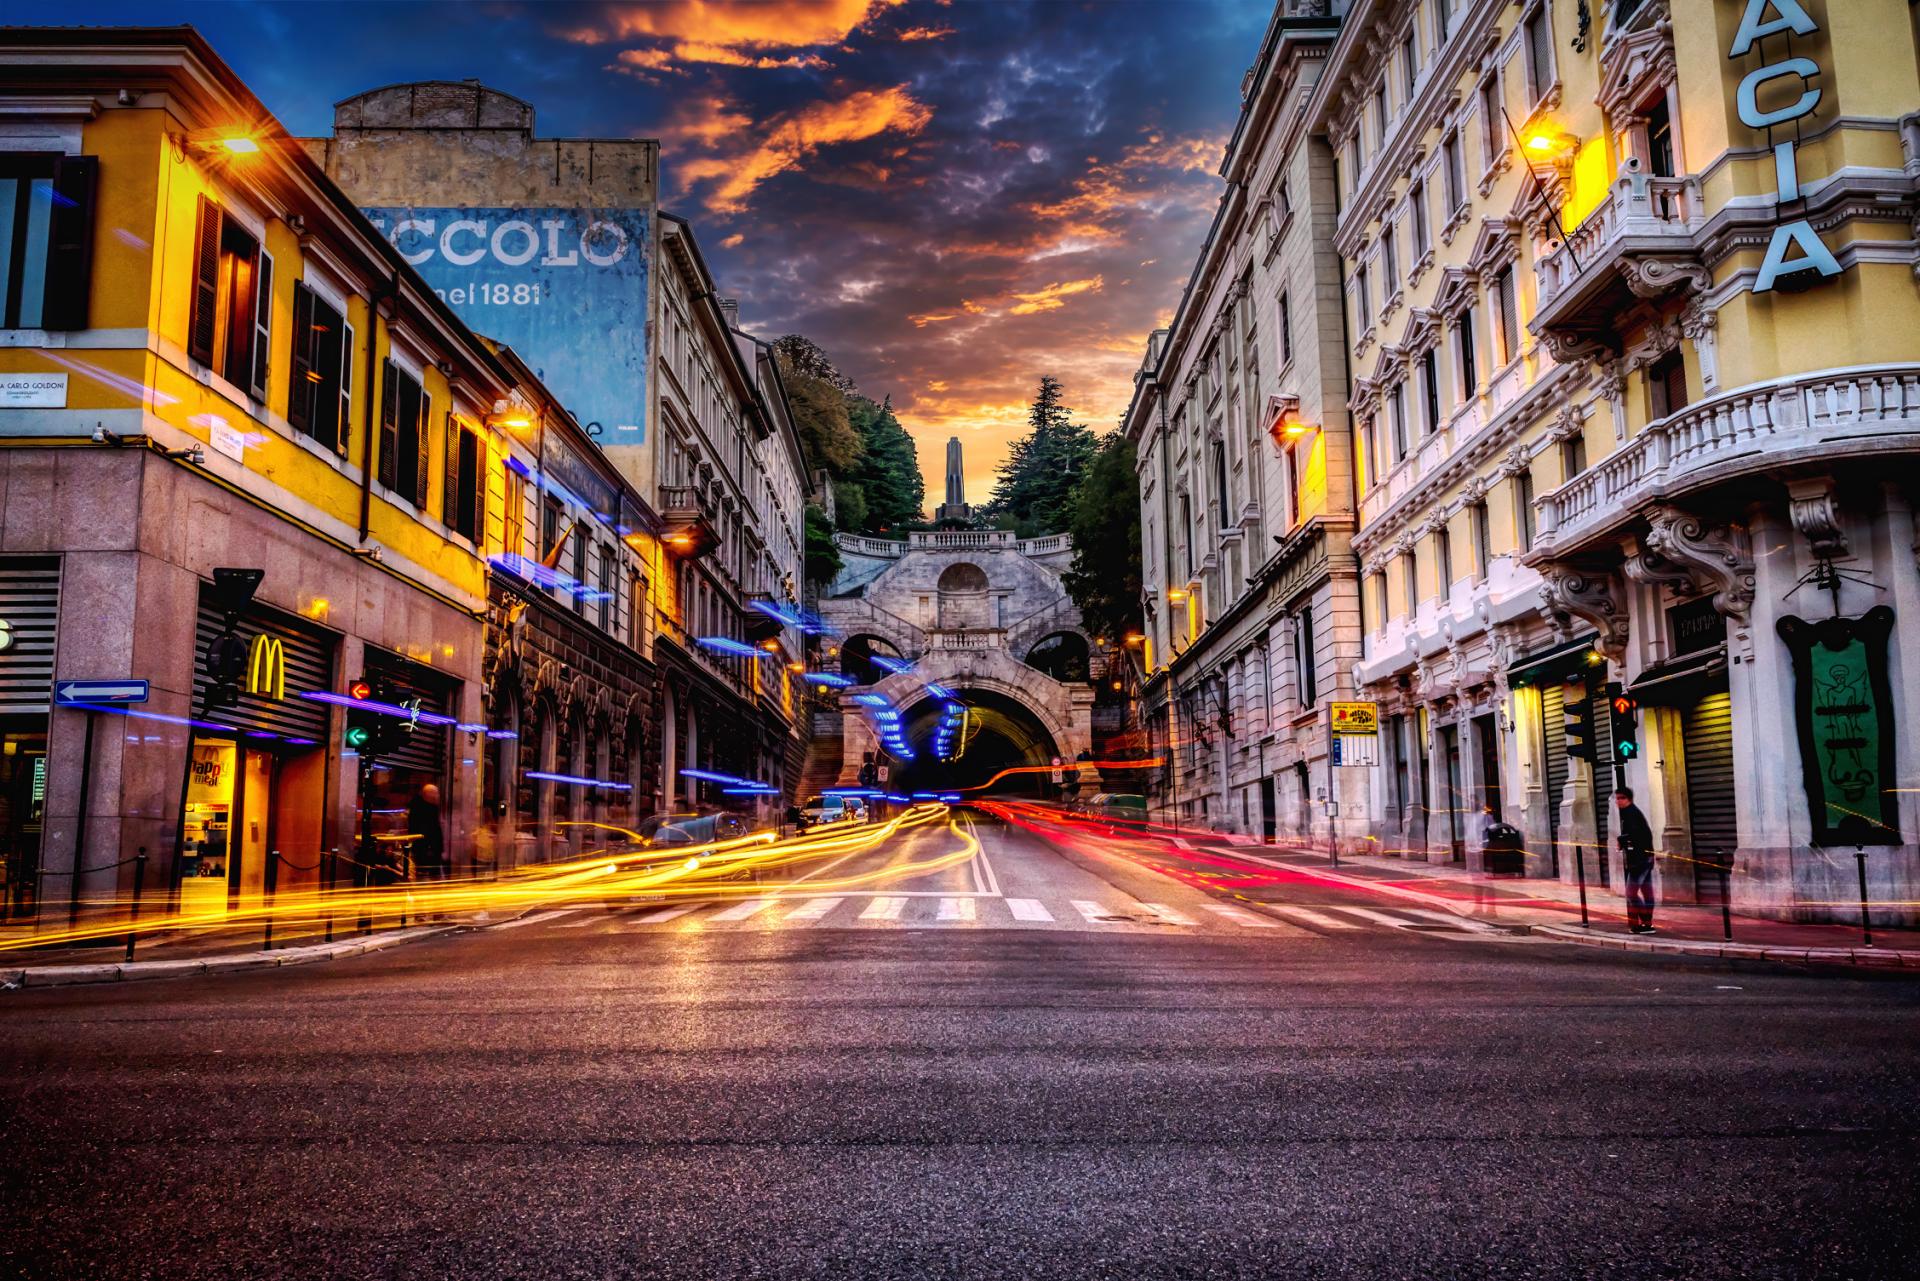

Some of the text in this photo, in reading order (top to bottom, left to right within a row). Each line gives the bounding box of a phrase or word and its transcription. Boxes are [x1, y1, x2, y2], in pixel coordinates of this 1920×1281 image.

[1728, 0, 1844, 293] ACIA
[371, 219, 629, 266] CCOLO
[481, 283, 540, 305] 1881
[194, 774, 218, 787] meal
